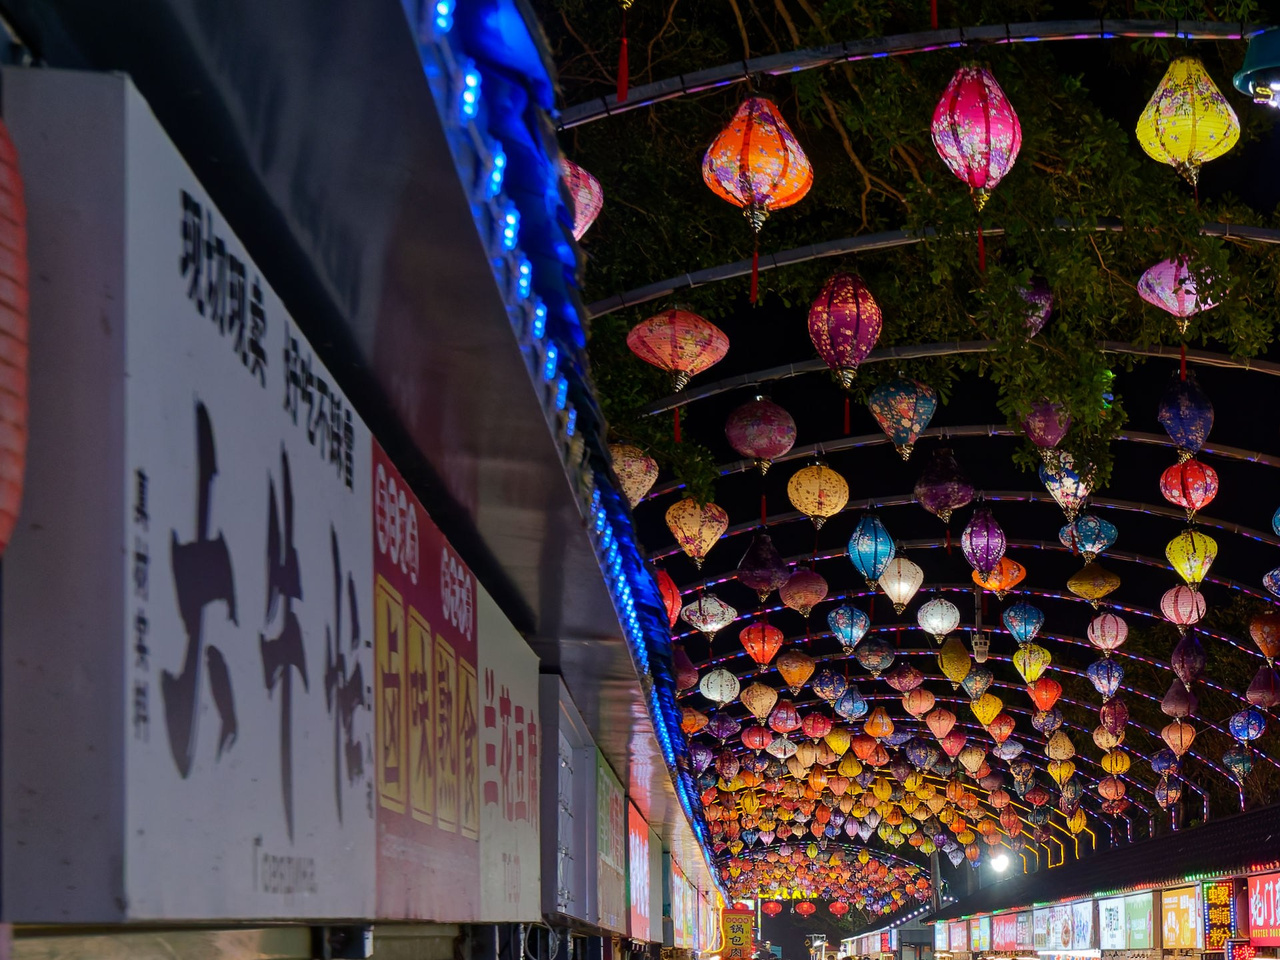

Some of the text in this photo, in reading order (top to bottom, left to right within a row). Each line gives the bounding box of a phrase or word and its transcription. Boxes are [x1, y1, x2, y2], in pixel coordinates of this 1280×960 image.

[380, 608, 477, 825] 卤味熟食
[728, 923, 745, 959] 锅包肉
[1207, 885, 1232, 946] 螺蛳粉
